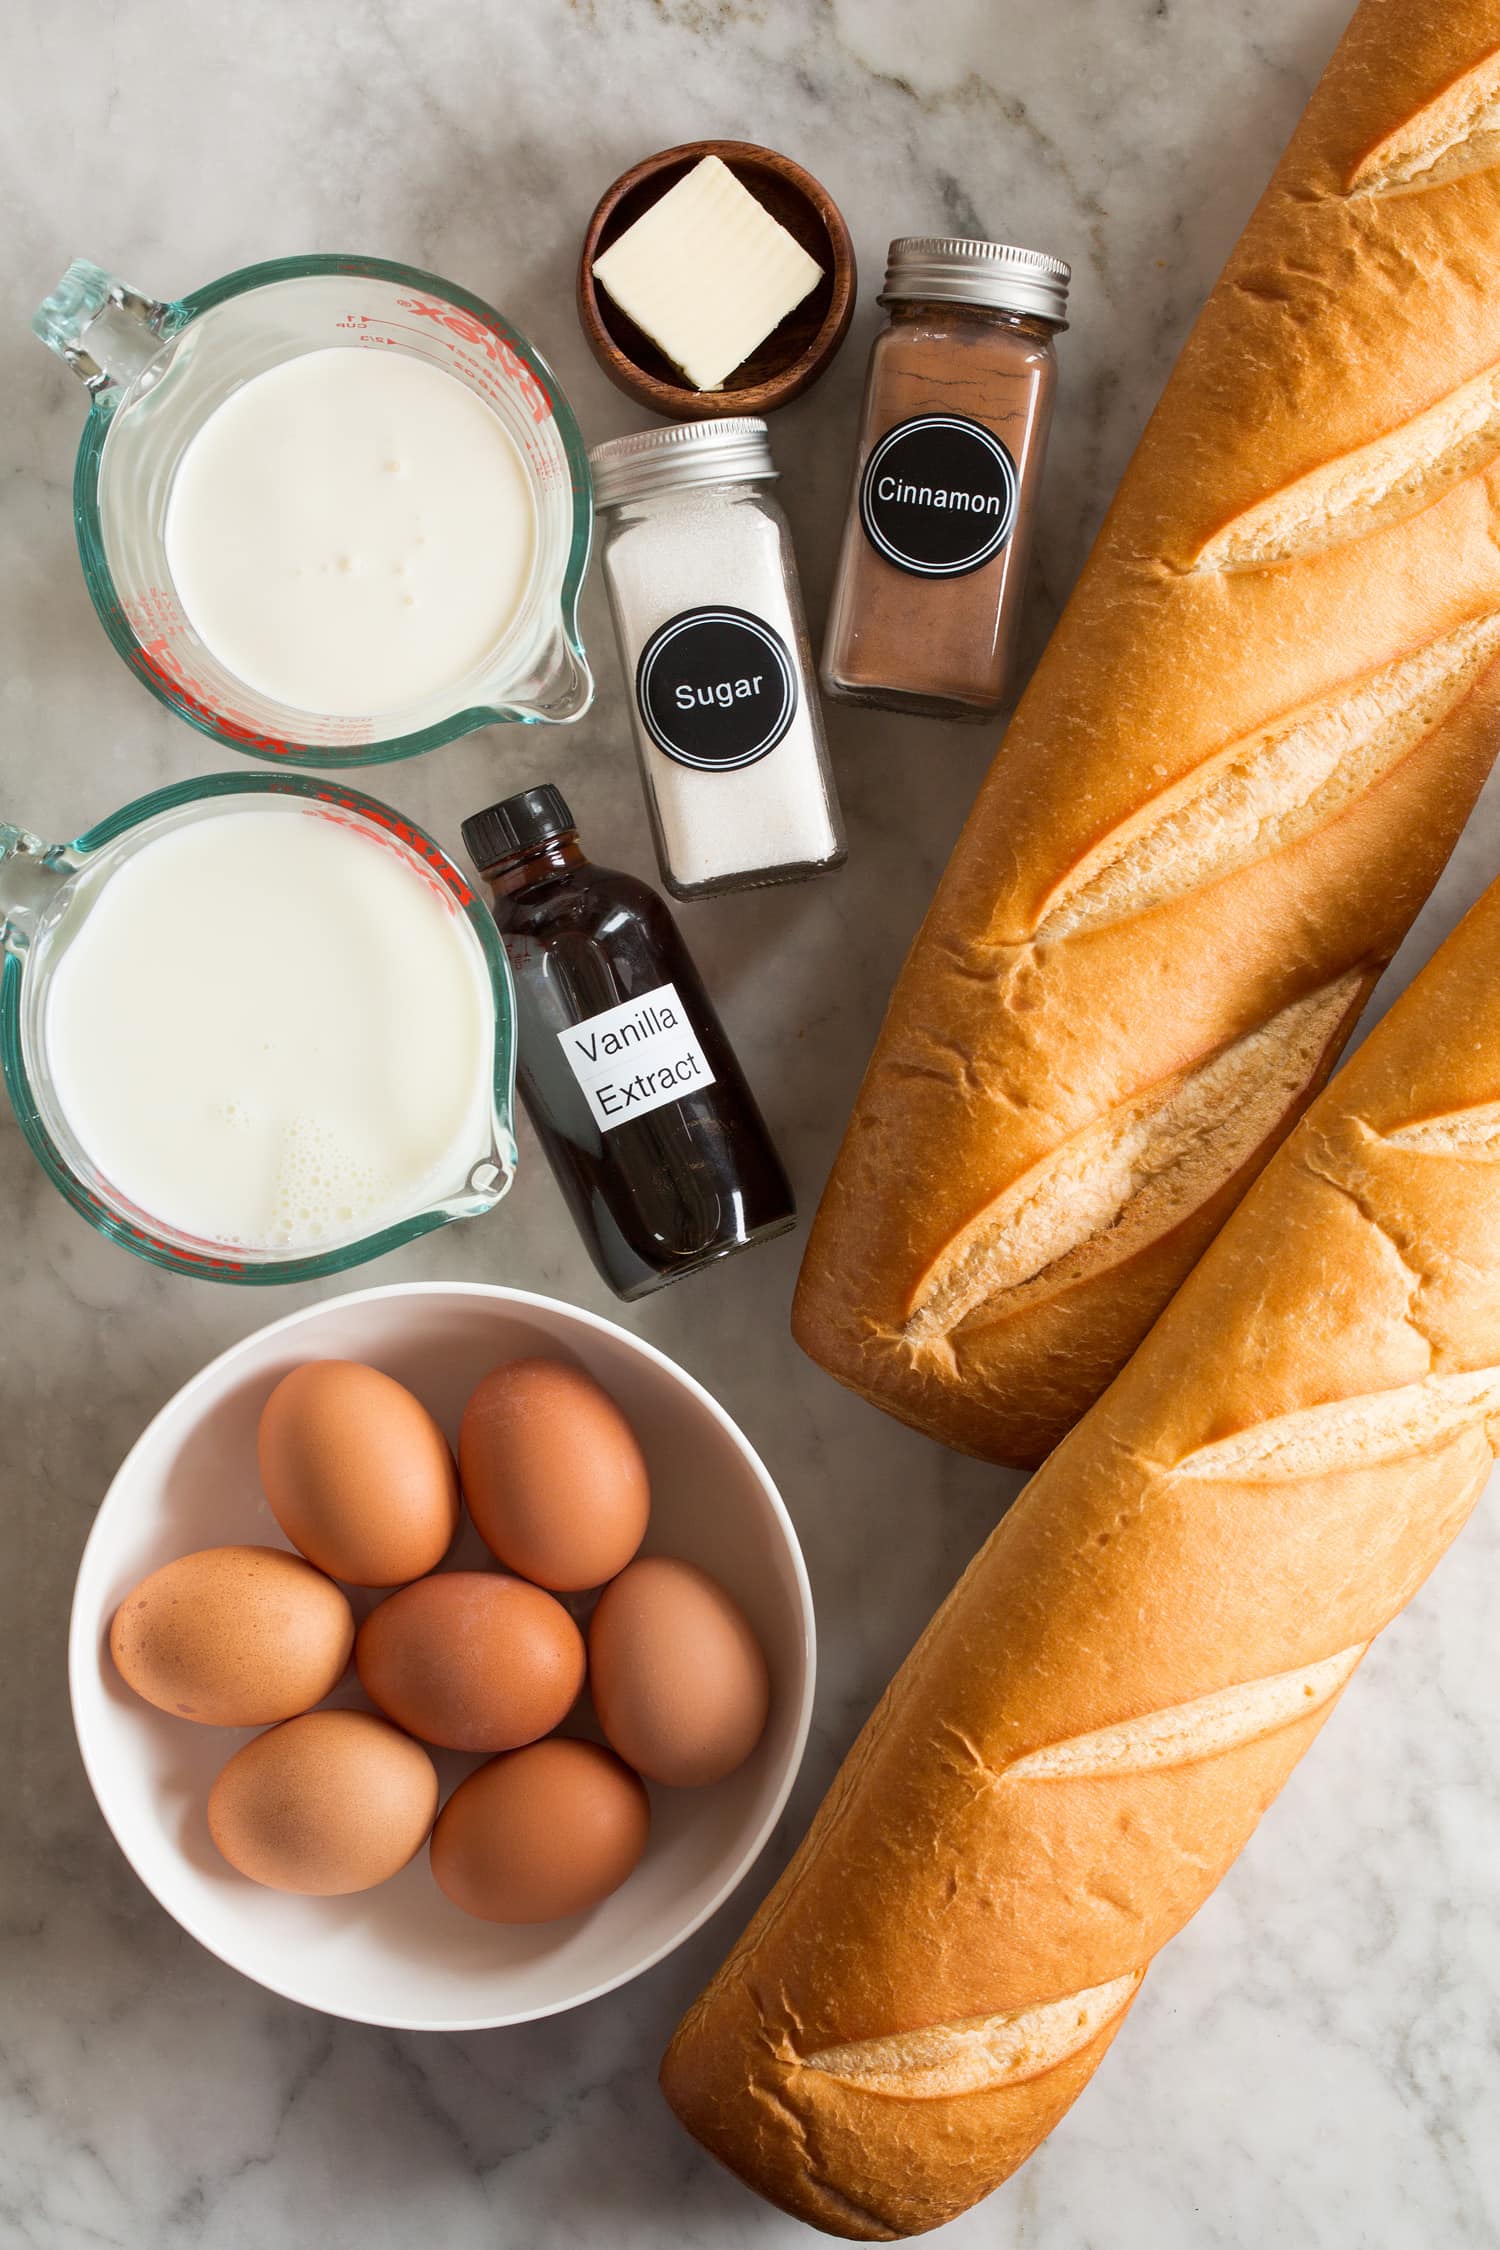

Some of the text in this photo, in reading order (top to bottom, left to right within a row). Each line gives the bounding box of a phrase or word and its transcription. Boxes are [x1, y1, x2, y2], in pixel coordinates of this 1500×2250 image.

[878, 476, 1001, 516] Cinnamon
[675, 675, 763, 710] Sugar
[575, 1007, 679, 1062] Vanilla
[595, 1052, 702, 1116] Extract
